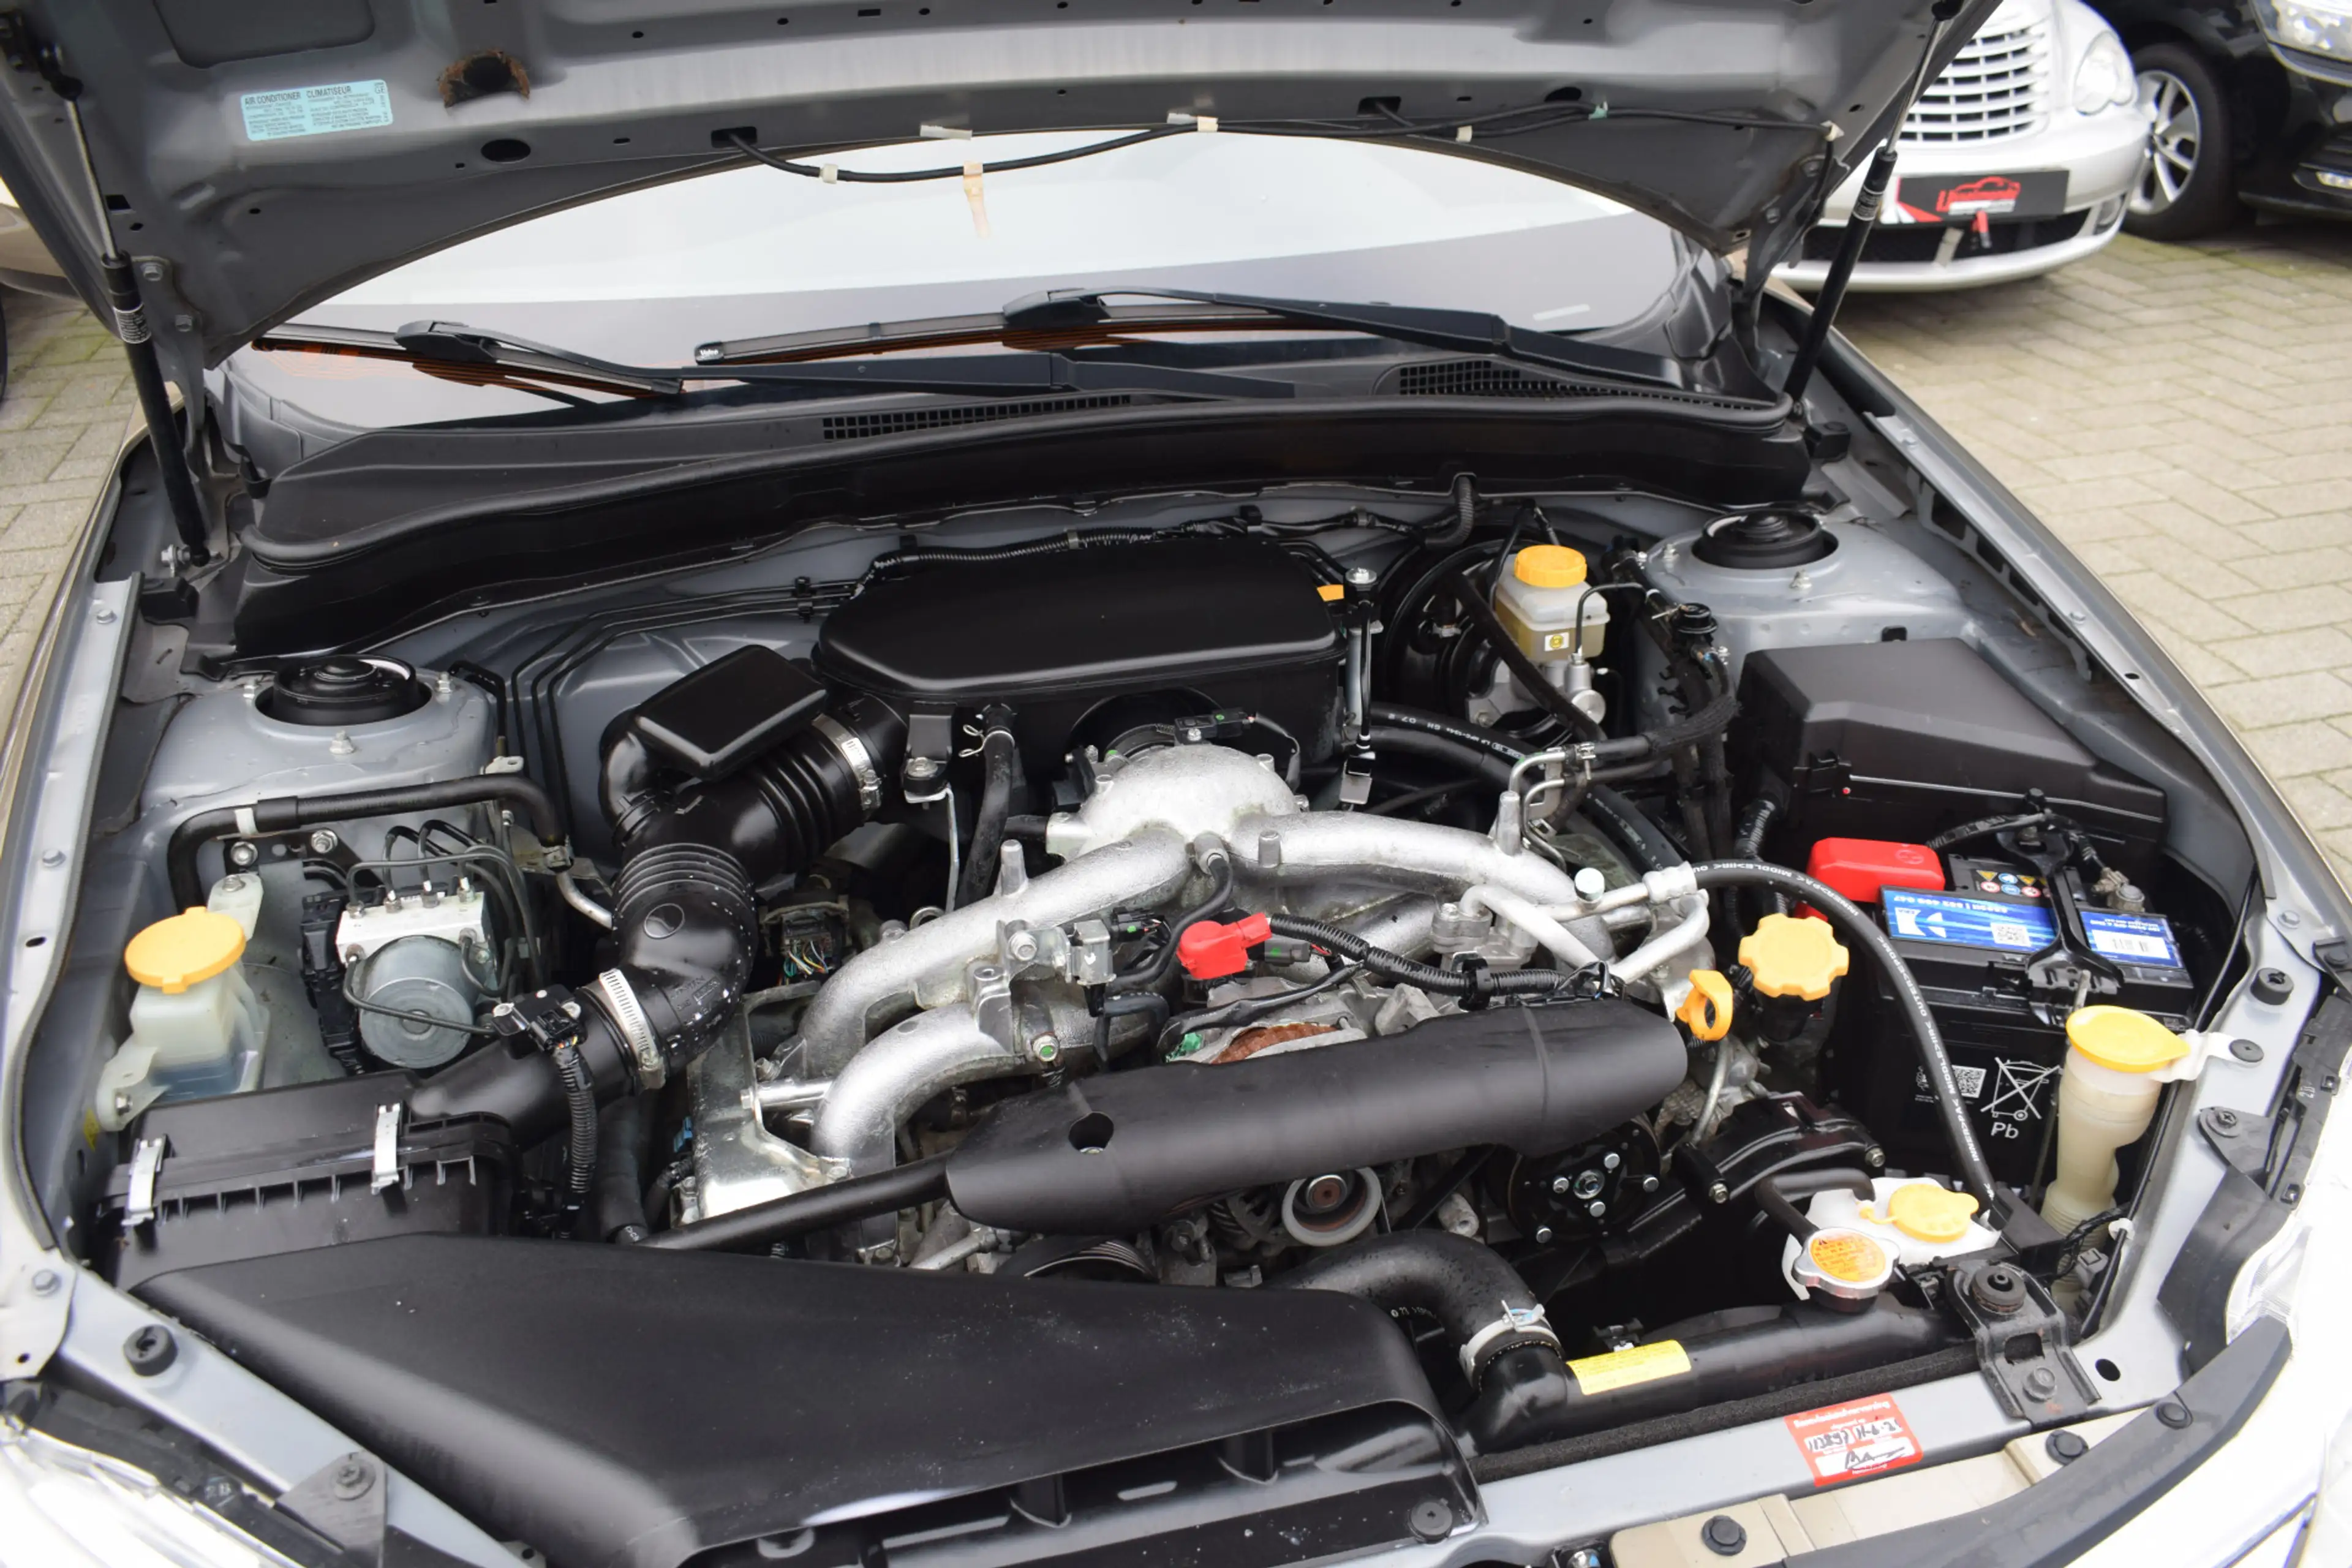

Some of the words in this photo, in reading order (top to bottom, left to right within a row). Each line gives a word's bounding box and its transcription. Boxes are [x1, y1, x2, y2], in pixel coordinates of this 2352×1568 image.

[257, 91, 301, 104] CONDITIONER
[306, 85, 352, 98] CLIMATISEUR
[1991, 1121, 2019, 1140] Pb
